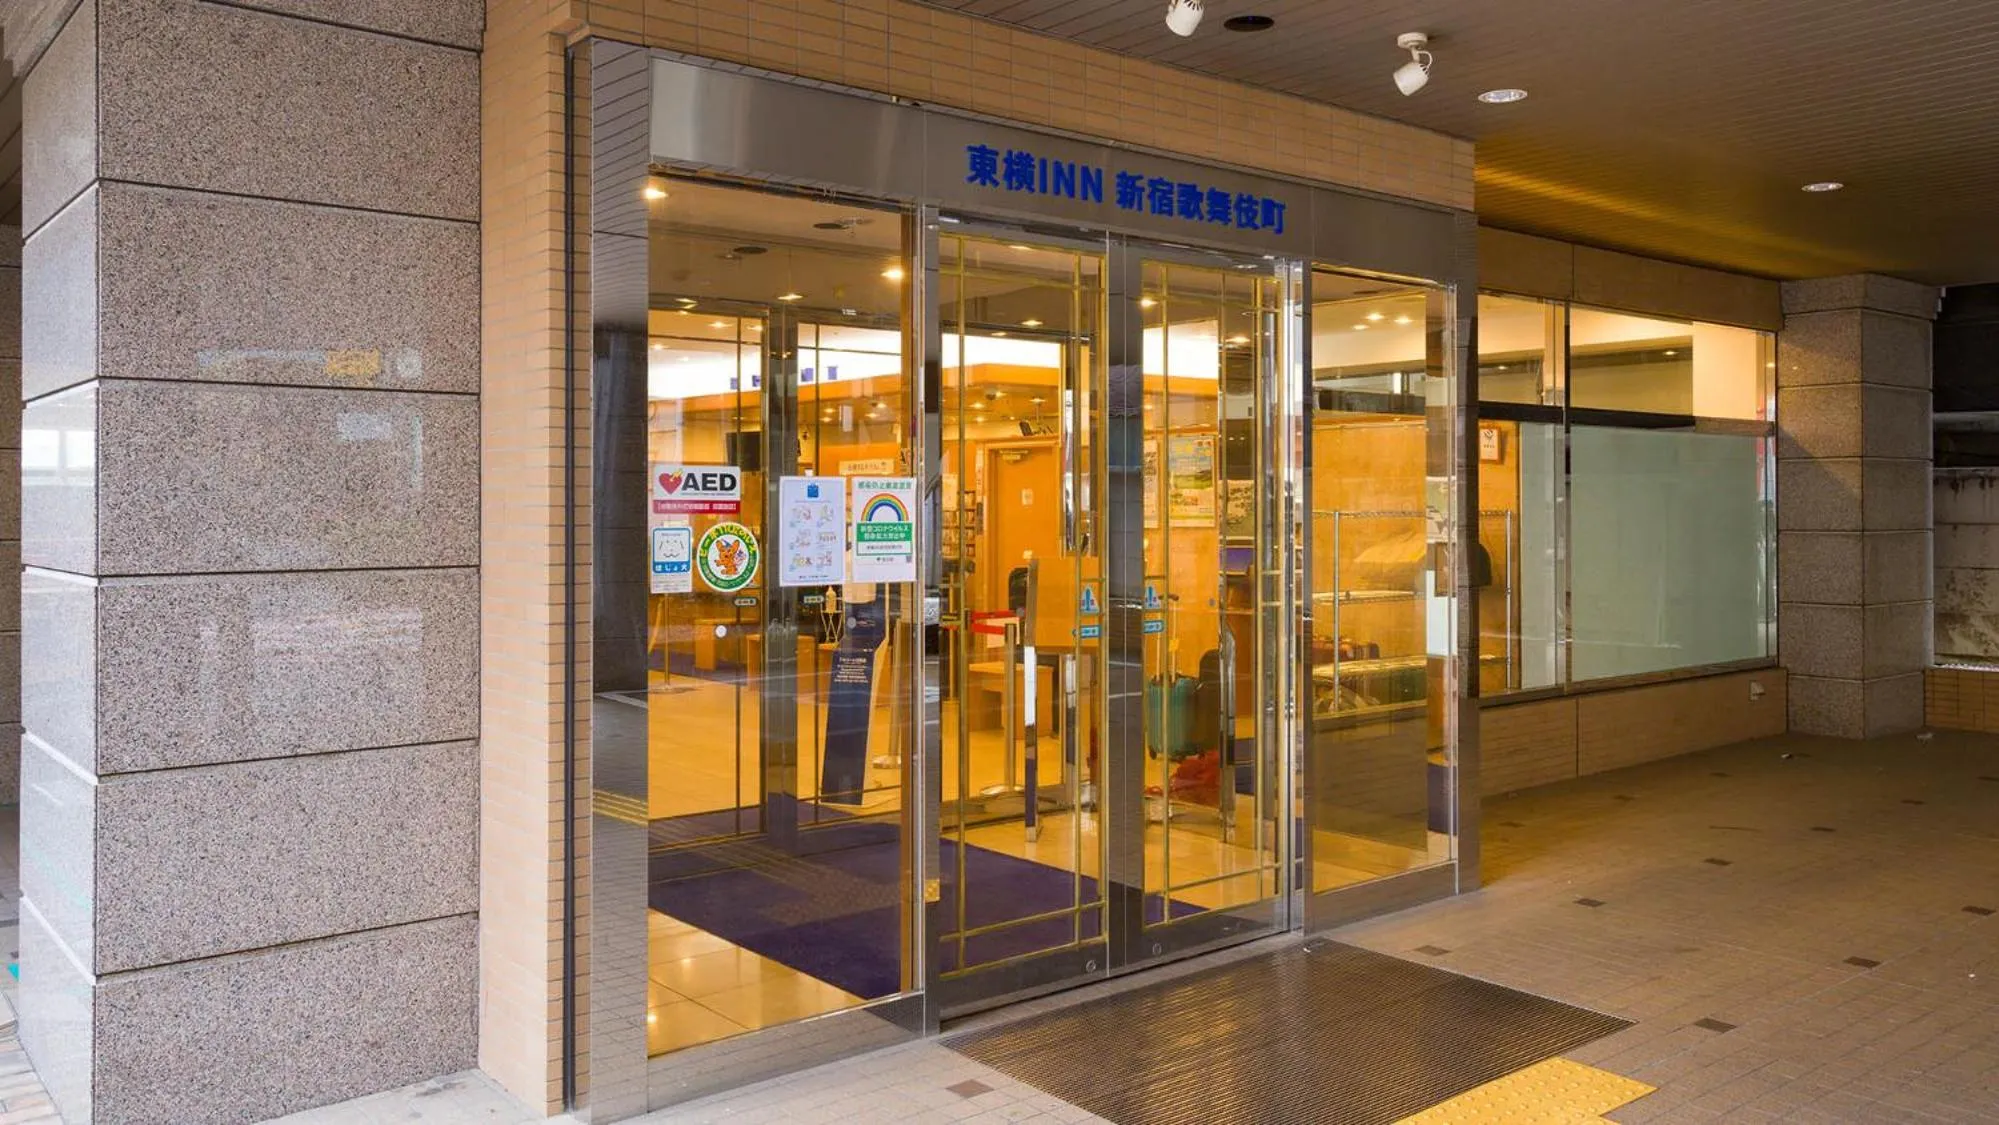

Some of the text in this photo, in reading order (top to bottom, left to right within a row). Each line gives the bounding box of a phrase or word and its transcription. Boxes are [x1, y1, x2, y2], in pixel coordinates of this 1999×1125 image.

[967, 144, 1286, 235] 東横INN 新宿歌舞伎町
[681, 473, 737, 491] AED
